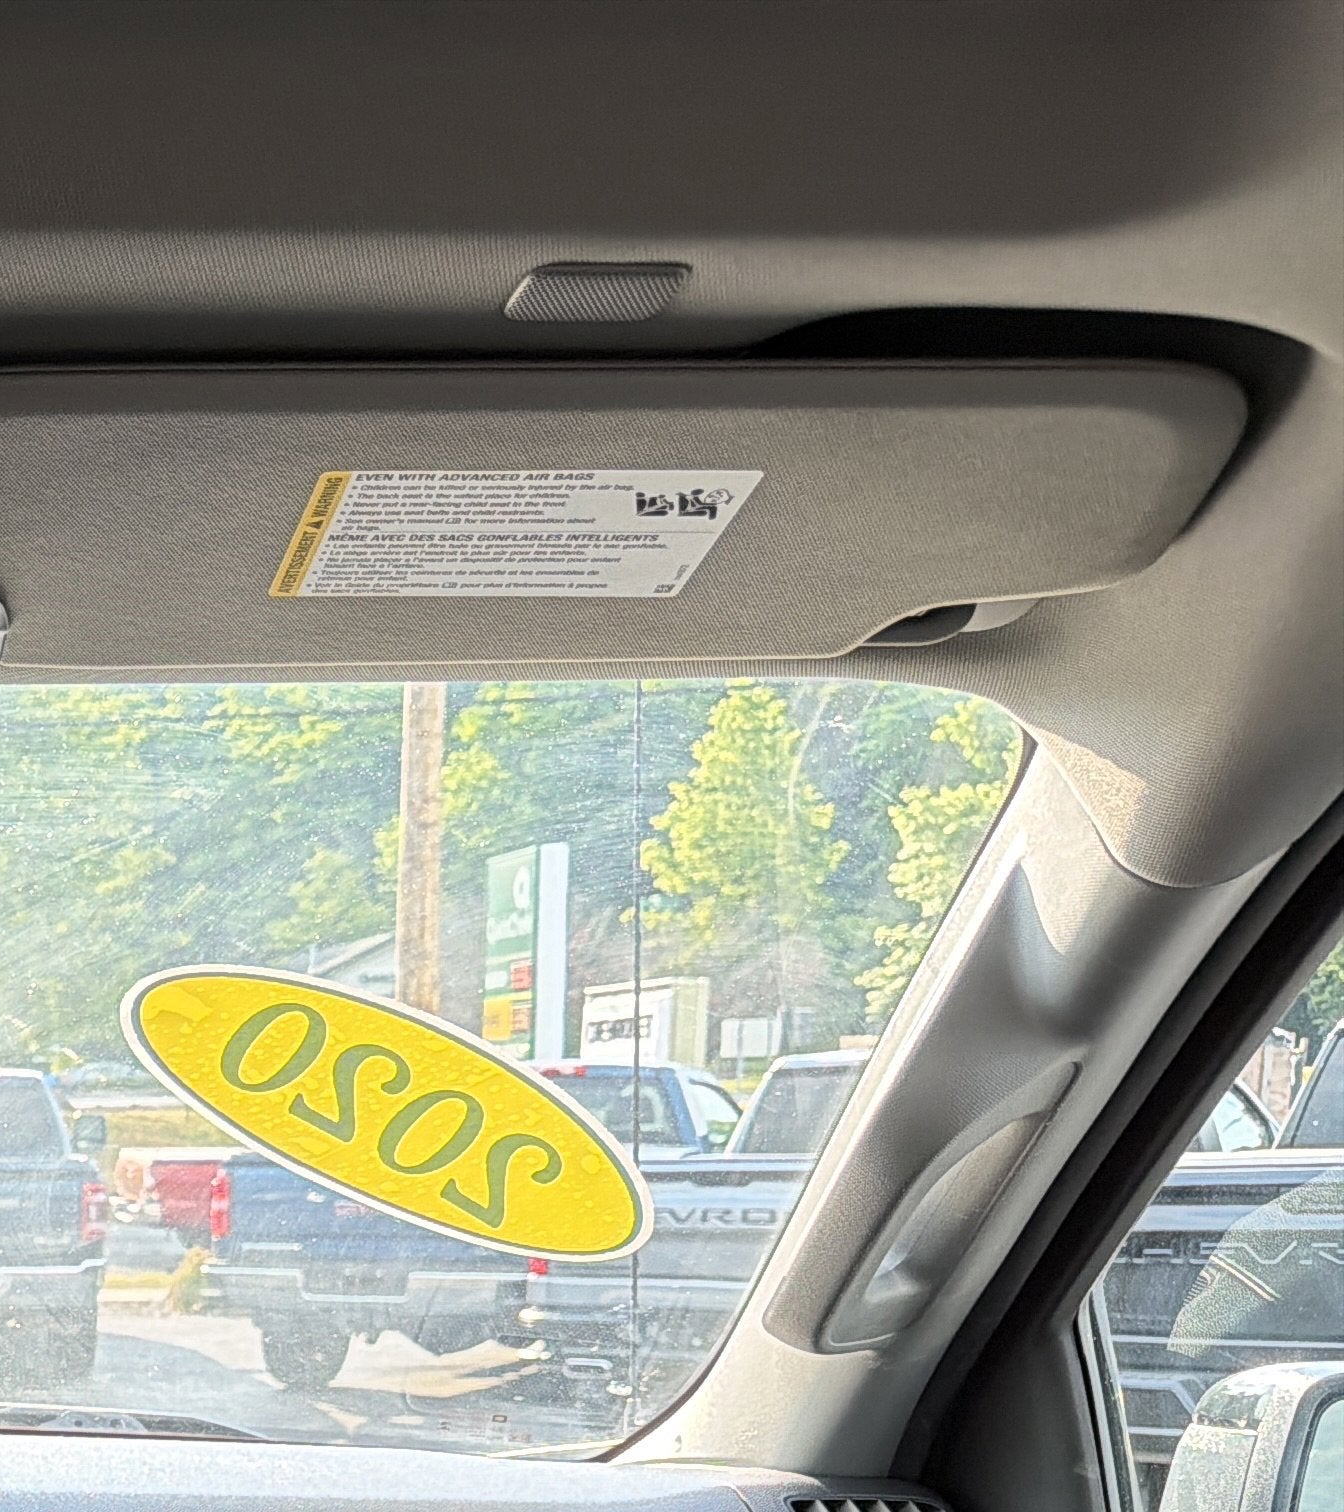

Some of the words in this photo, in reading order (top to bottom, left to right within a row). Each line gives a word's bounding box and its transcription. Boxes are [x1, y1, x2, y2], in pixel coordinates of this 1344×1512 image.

[355, 473, 394, 481] EVEN
[398, 473, 436, 481] WITH
[439, 473, 520, 481] ADVANCED
[523, 473, 550, 481] AIR
[553, 473, 595, 481] BAGS
[313, 477, 344, 518] WARNING
[328, 533, 368, 541] MÊME
[371, 533, 406, 541] AVEC
[409, 533, 435, 541] DES
[438, 533, 474, 541] SACS
[477, 533, 563, 541] GONFLABLES
[566, 533, 660, 541] INTELLIGENTS
[277, 530, 317, 594] AVERTISSEMENT
